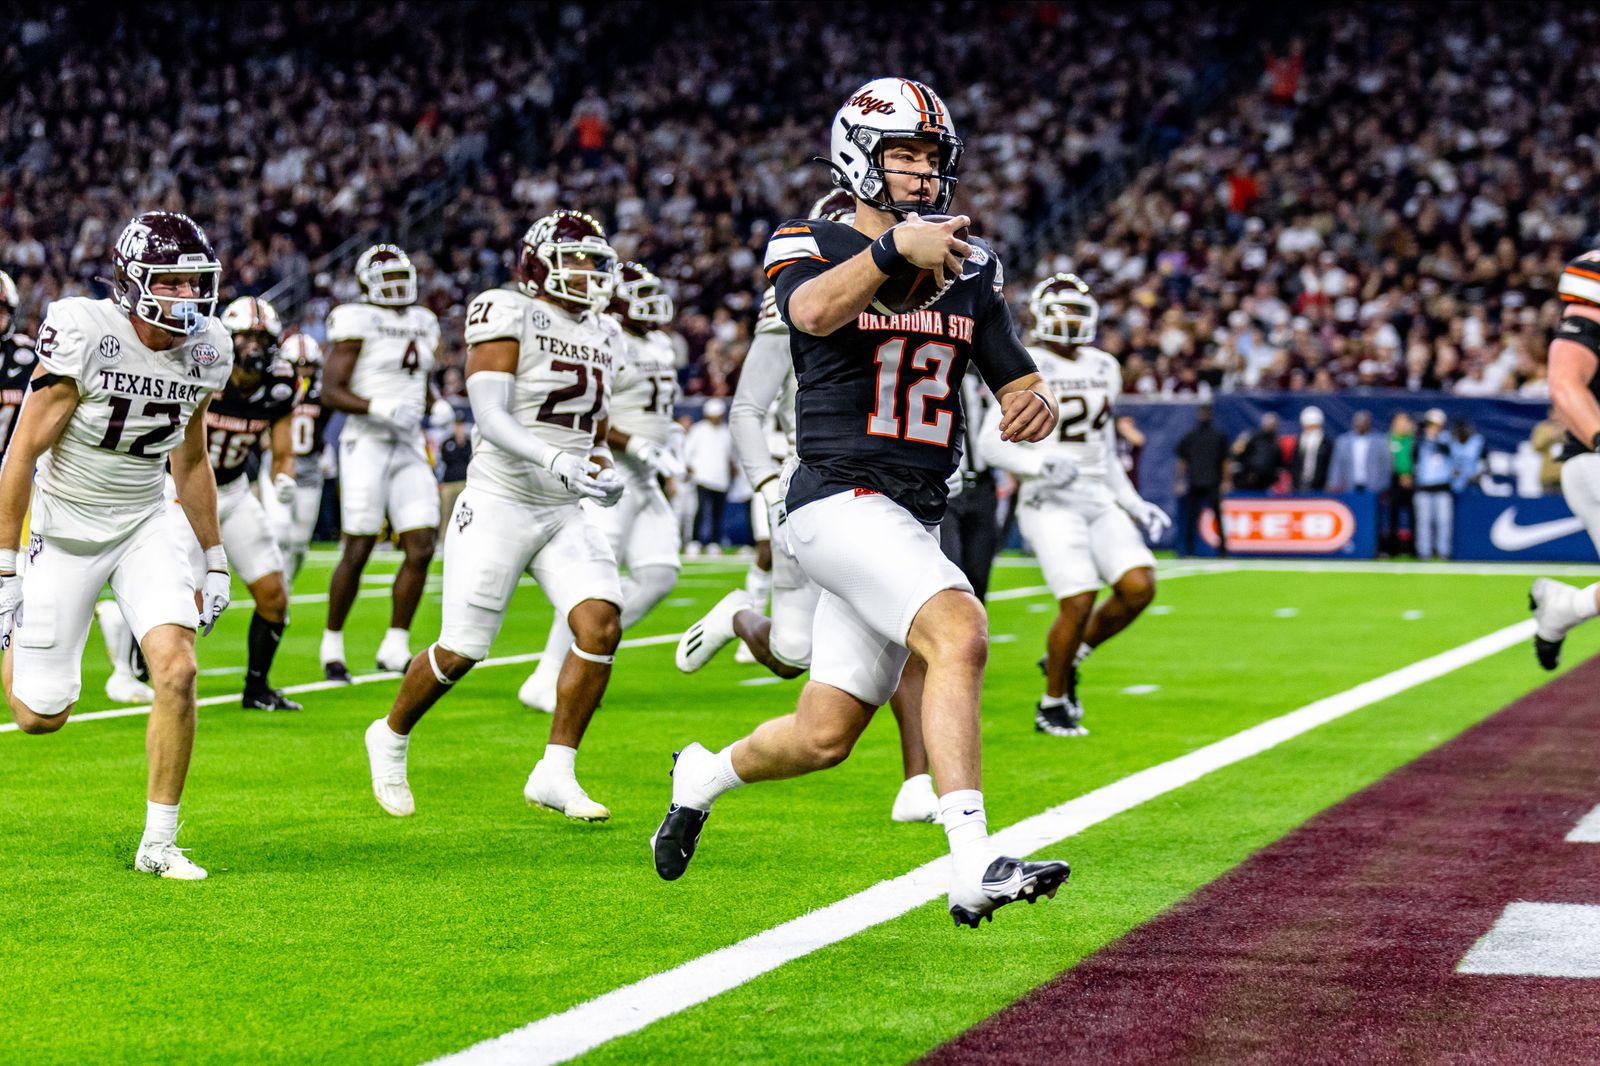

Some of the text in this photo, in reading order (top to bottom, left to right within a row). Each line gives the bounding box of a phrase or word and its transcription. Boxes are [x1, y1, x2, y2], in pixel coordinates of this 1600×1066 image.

[468, 301, 493, 327] 21
[100, 335, 119, 357] SEC
[402, 341, 419, 376] 4
[535, 334, 589, 361] TEXAS
[100, 370, 202, 402] TEXAS A&M
[536, 359, 604, 434] 21
[867, 335, 957, 448] 12
[99, 396, 181, 459] 12
